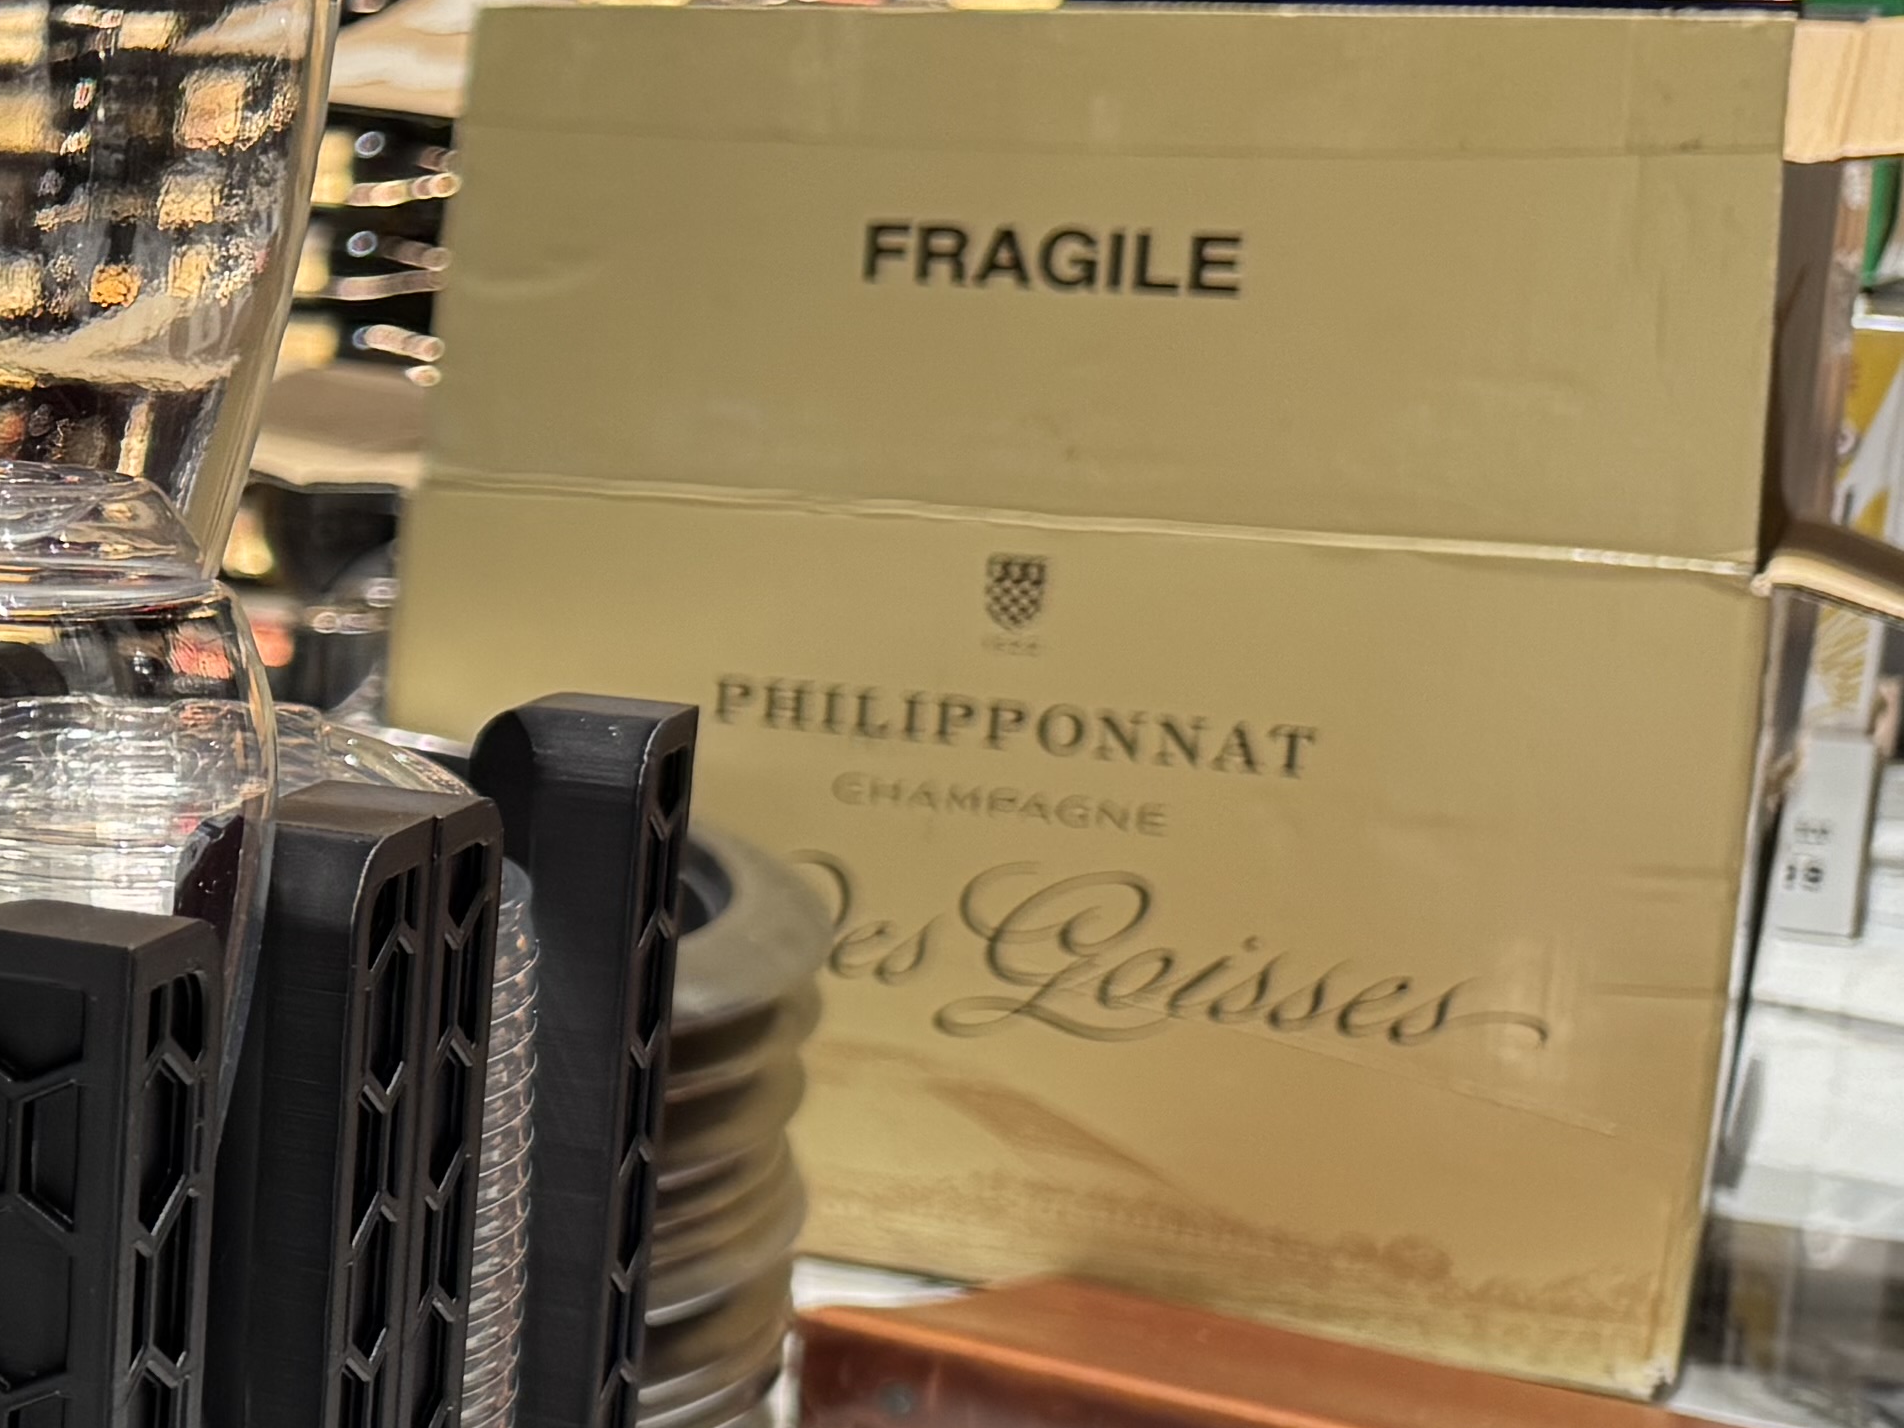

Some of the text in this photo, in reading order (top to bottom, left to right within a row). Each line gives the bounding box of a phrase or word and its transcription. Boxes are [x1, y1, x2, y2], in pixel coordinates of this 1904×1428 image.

[862, 221, 1243, 299] FRAGILE
[713, 673, 1320, 780] PHILIPPONNAT
[830, 771, 1171, 838] CHAMPAGNE
[930, 859, 1550, 1045] Goisses
